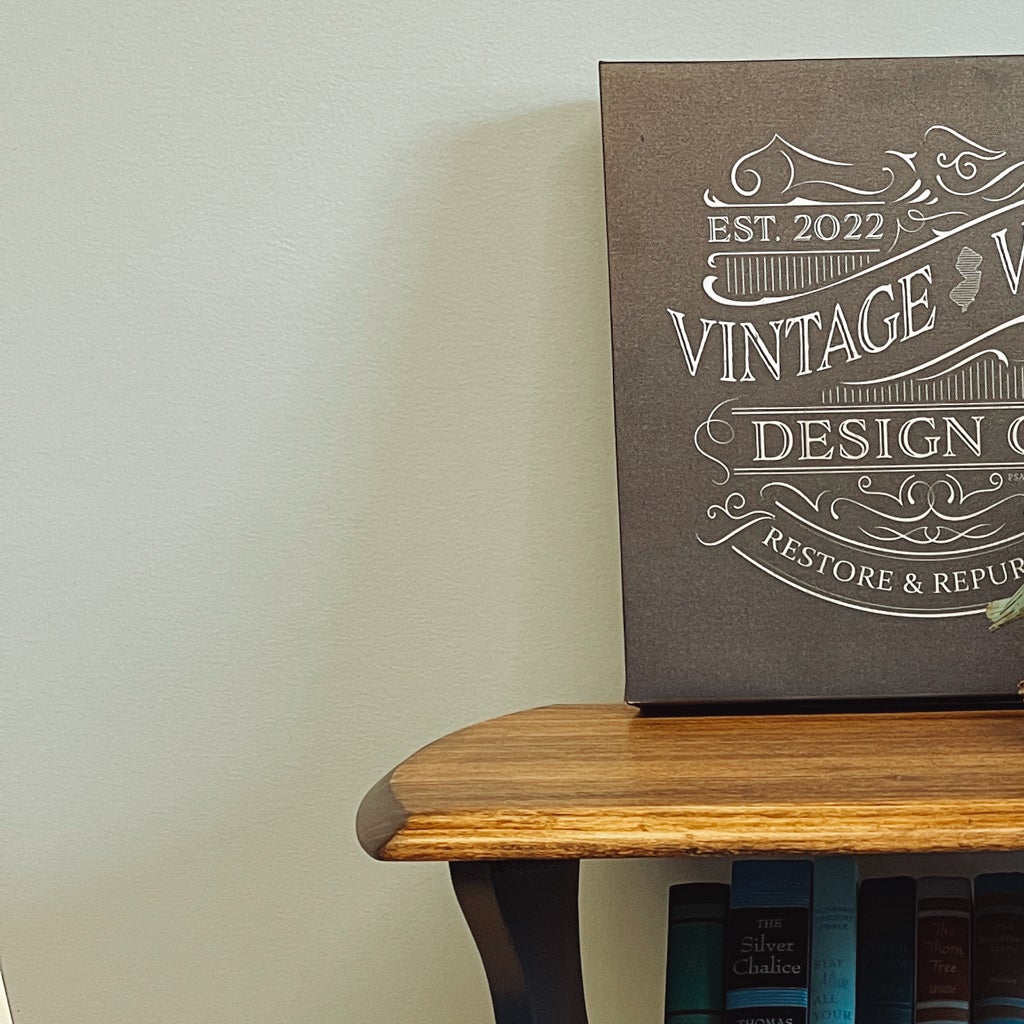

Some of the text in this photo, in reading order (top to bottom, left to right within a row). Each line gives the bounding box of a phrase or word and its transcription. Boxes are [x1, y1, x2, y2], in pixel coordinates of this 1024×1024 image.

[707, 212, 884, 243] EST. 2022
[667, 264, 938, 383] VINTAGE
[751, 415, 985, 462] DESIGN
[761, 526, 894, 592] RESTORE
[903, 572, 924, 595] &
[756, 919, 782, 929] THE
[931, 921, 957, 937] The
[740, 935, 795, 953] Silver
[923, 940, 964, 956] Thorn
[732, 956, 802, 976] Chalice
[813, 959, 845, 971] STAY
[928, 959, 958, 974] Tree
[813, 994, 838, 1006] ALL
[813, 1009, 852, 1020] YOUR
